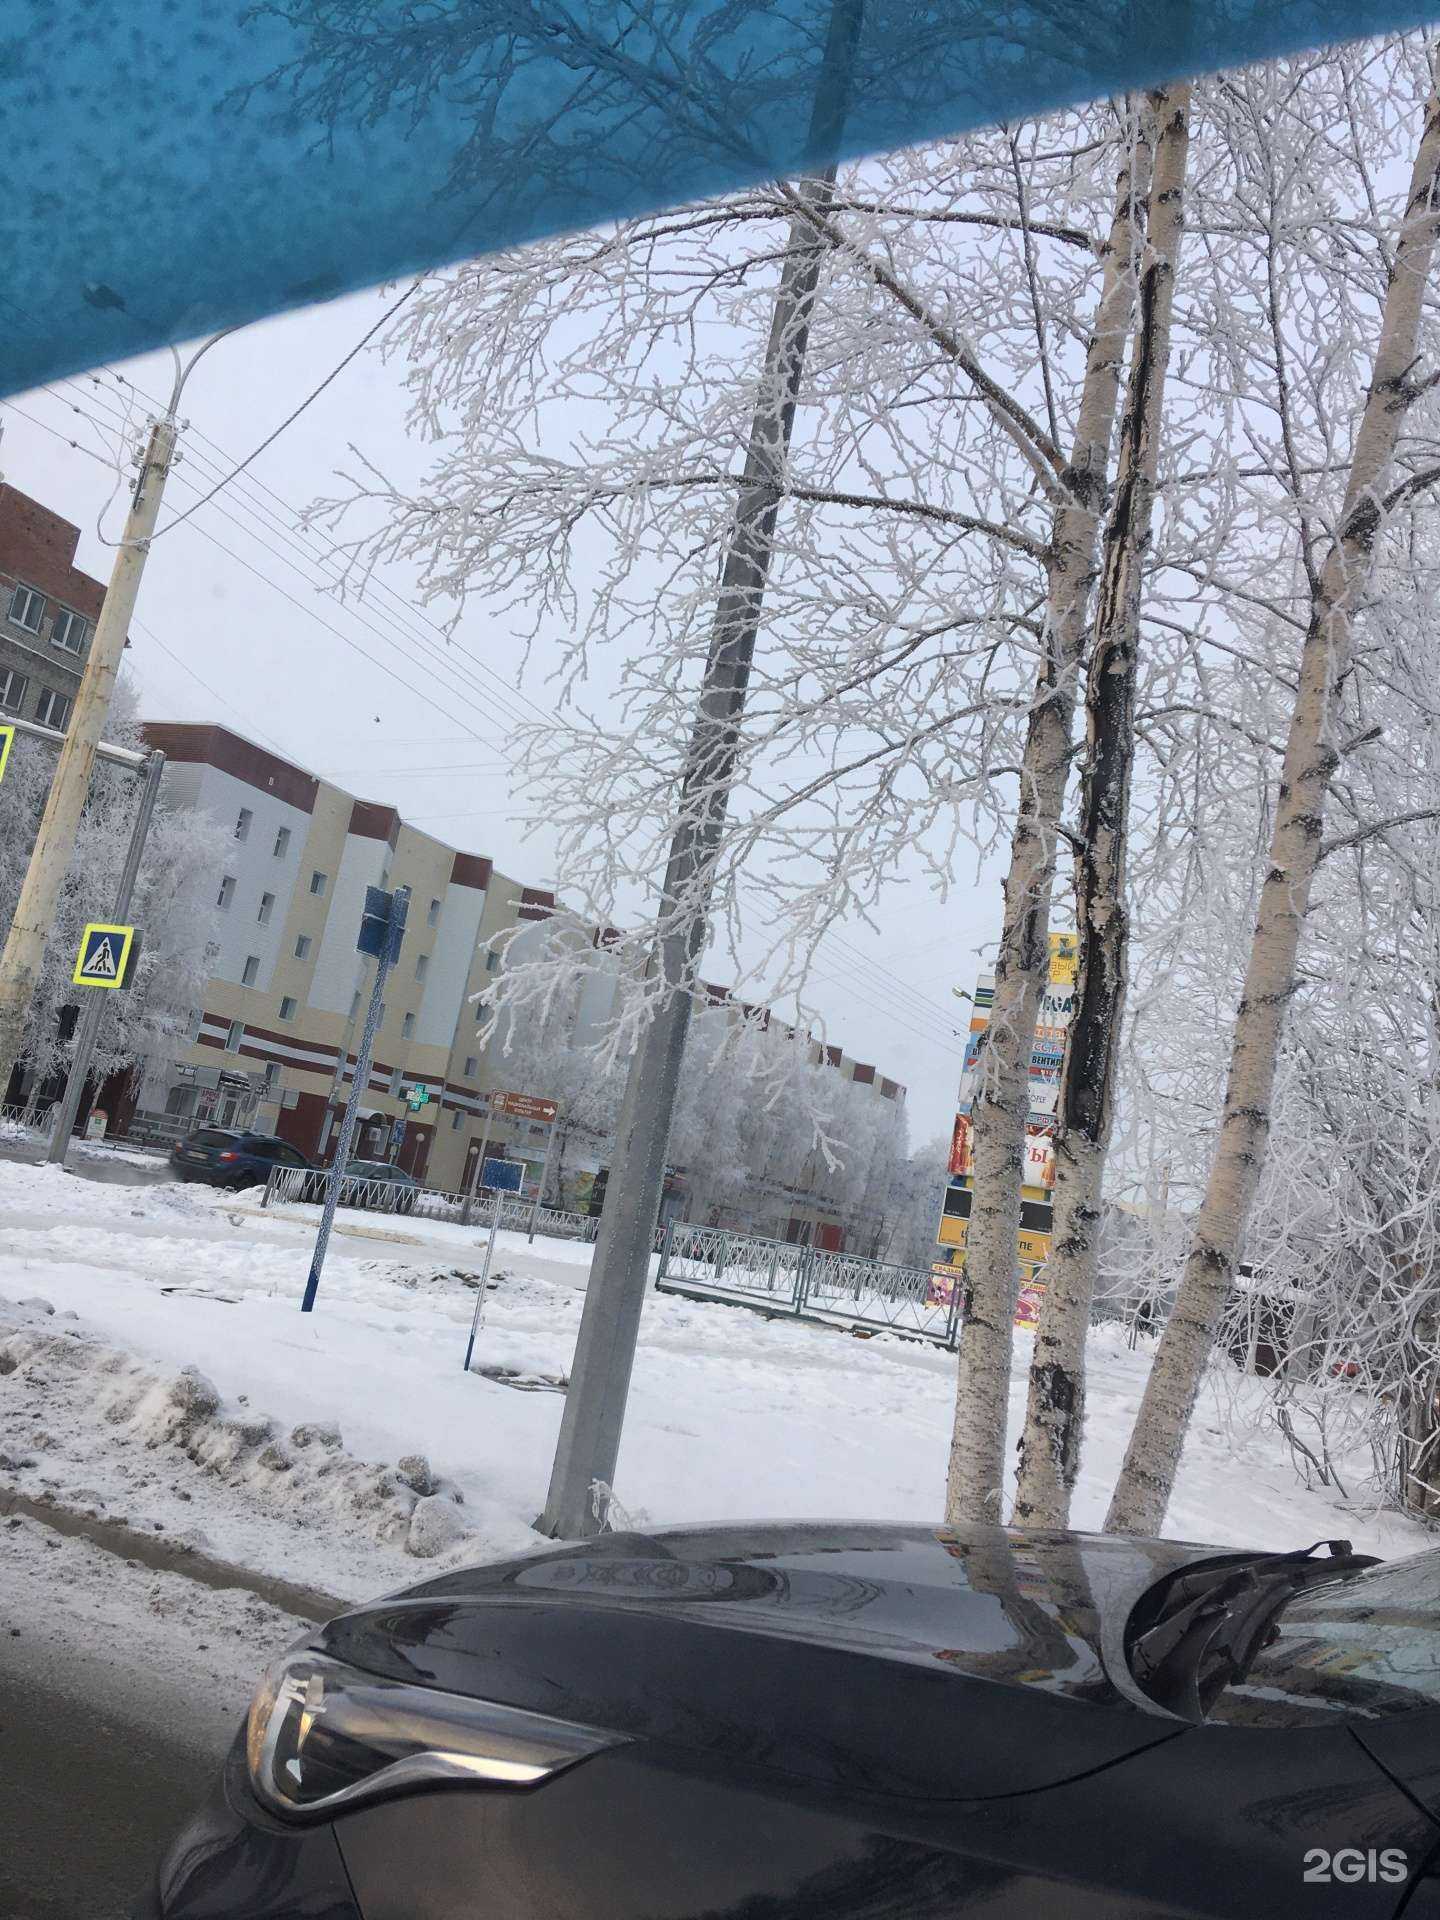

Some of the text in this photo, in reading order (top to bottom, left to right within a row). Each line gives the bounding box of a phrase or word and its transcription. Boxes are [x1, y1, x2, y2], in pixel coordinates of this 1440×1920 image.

[1031, 1056, 1063, 1066] ВЕНТИЛ
[1029, 1146, 1048, 1164] Ы
[1019, 1241, 1033, 1251] ПЕ
